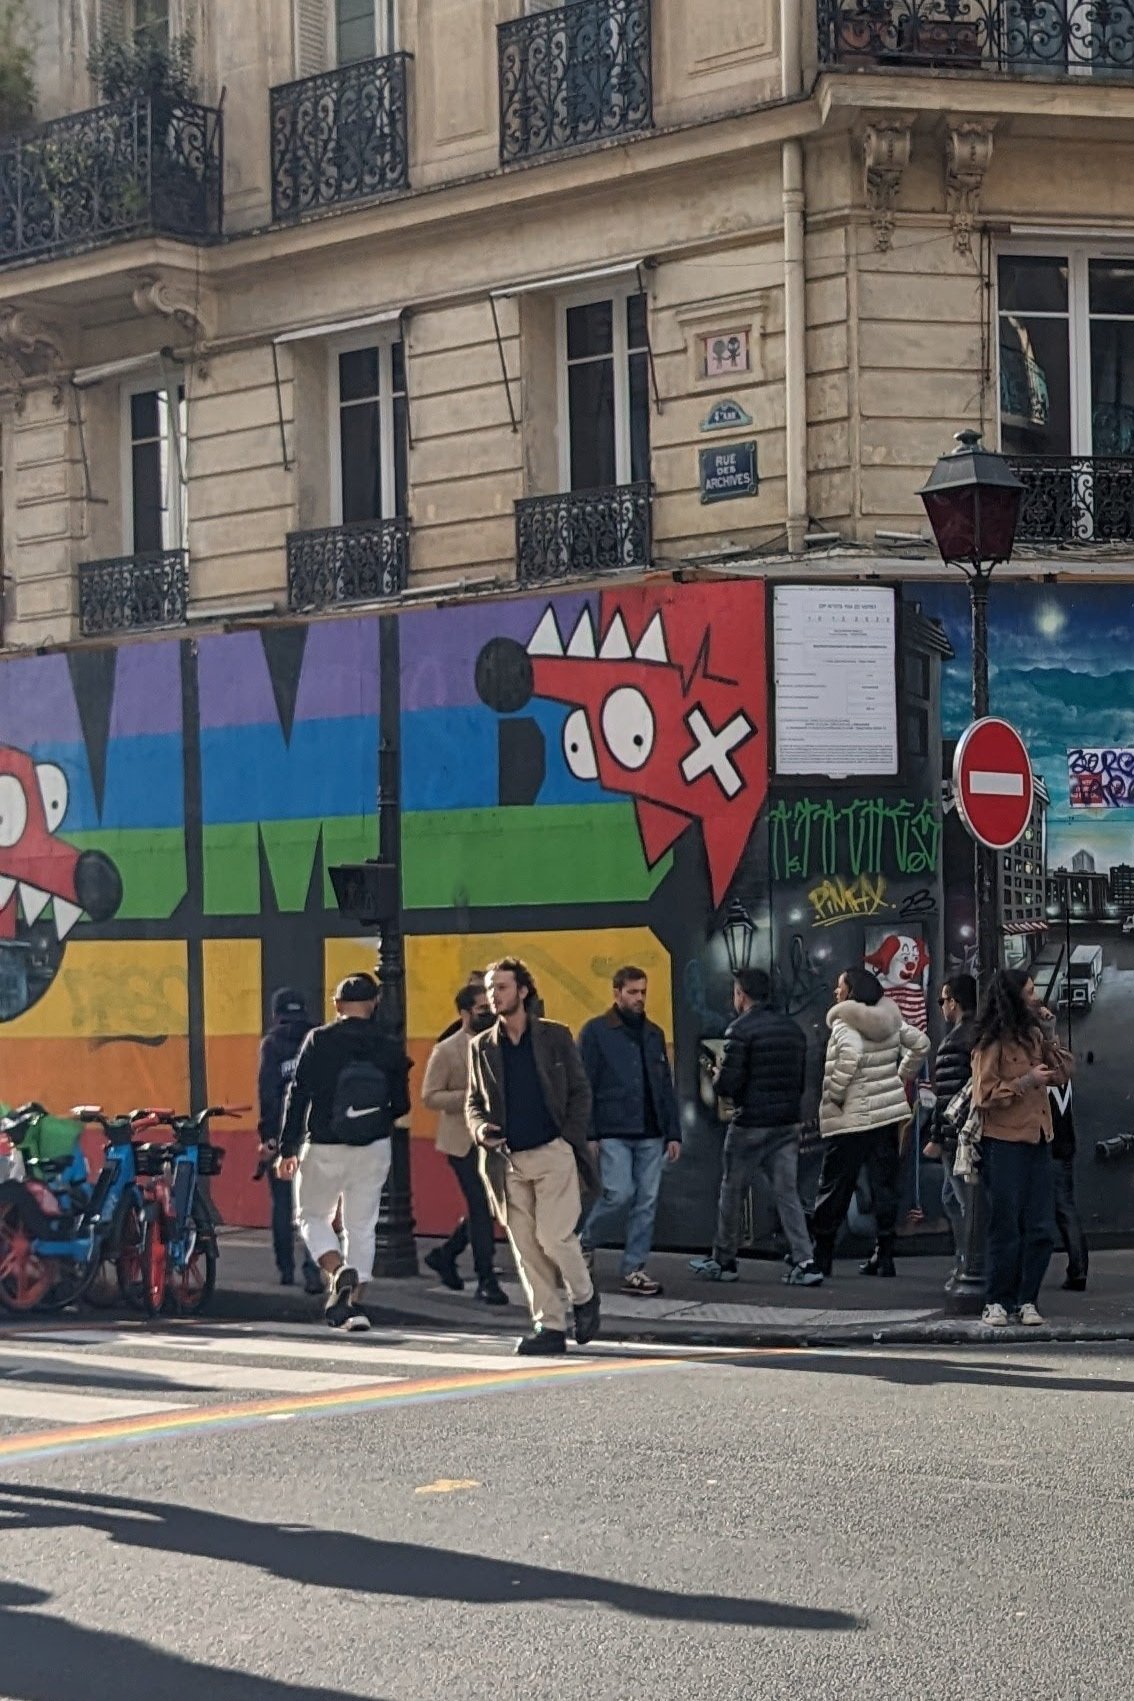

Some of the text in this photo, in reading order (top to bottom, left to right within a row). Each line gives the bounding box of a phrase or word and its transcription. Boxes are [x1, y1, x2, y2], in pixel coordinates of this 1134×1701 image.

[715, 453, 737, 467] RUE
[716, 465, 737, 476] DES
[705, 472, 751, 490] ARCHIVES
